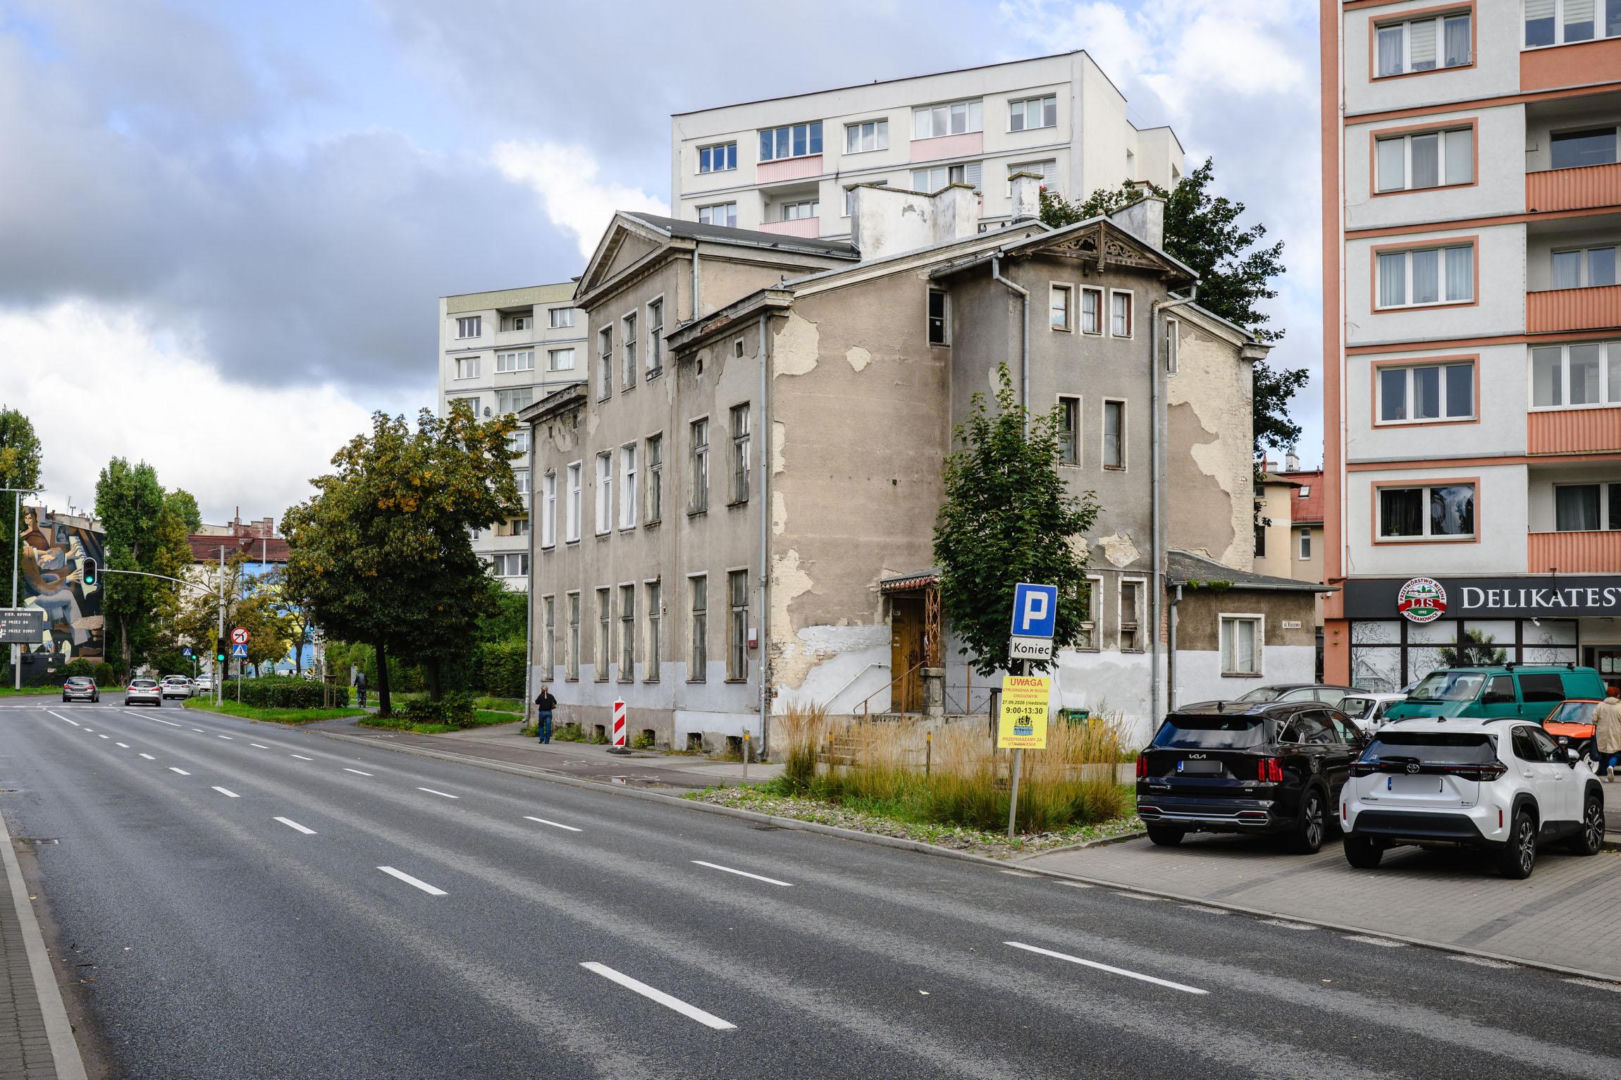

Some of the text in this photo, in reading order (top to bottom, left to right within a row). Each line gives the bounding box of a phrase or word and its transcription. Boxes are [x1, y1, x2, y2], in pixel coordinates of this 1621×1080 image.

[1410, 598, 1434, 609] LIS
[1022, 590, 1049, 630] P
[1013, 642, 1050, 655] Koniec
[1010, 678, 1043, 687] UWAGA
[1005, 706, 1043, 714] 9:00-13:30
